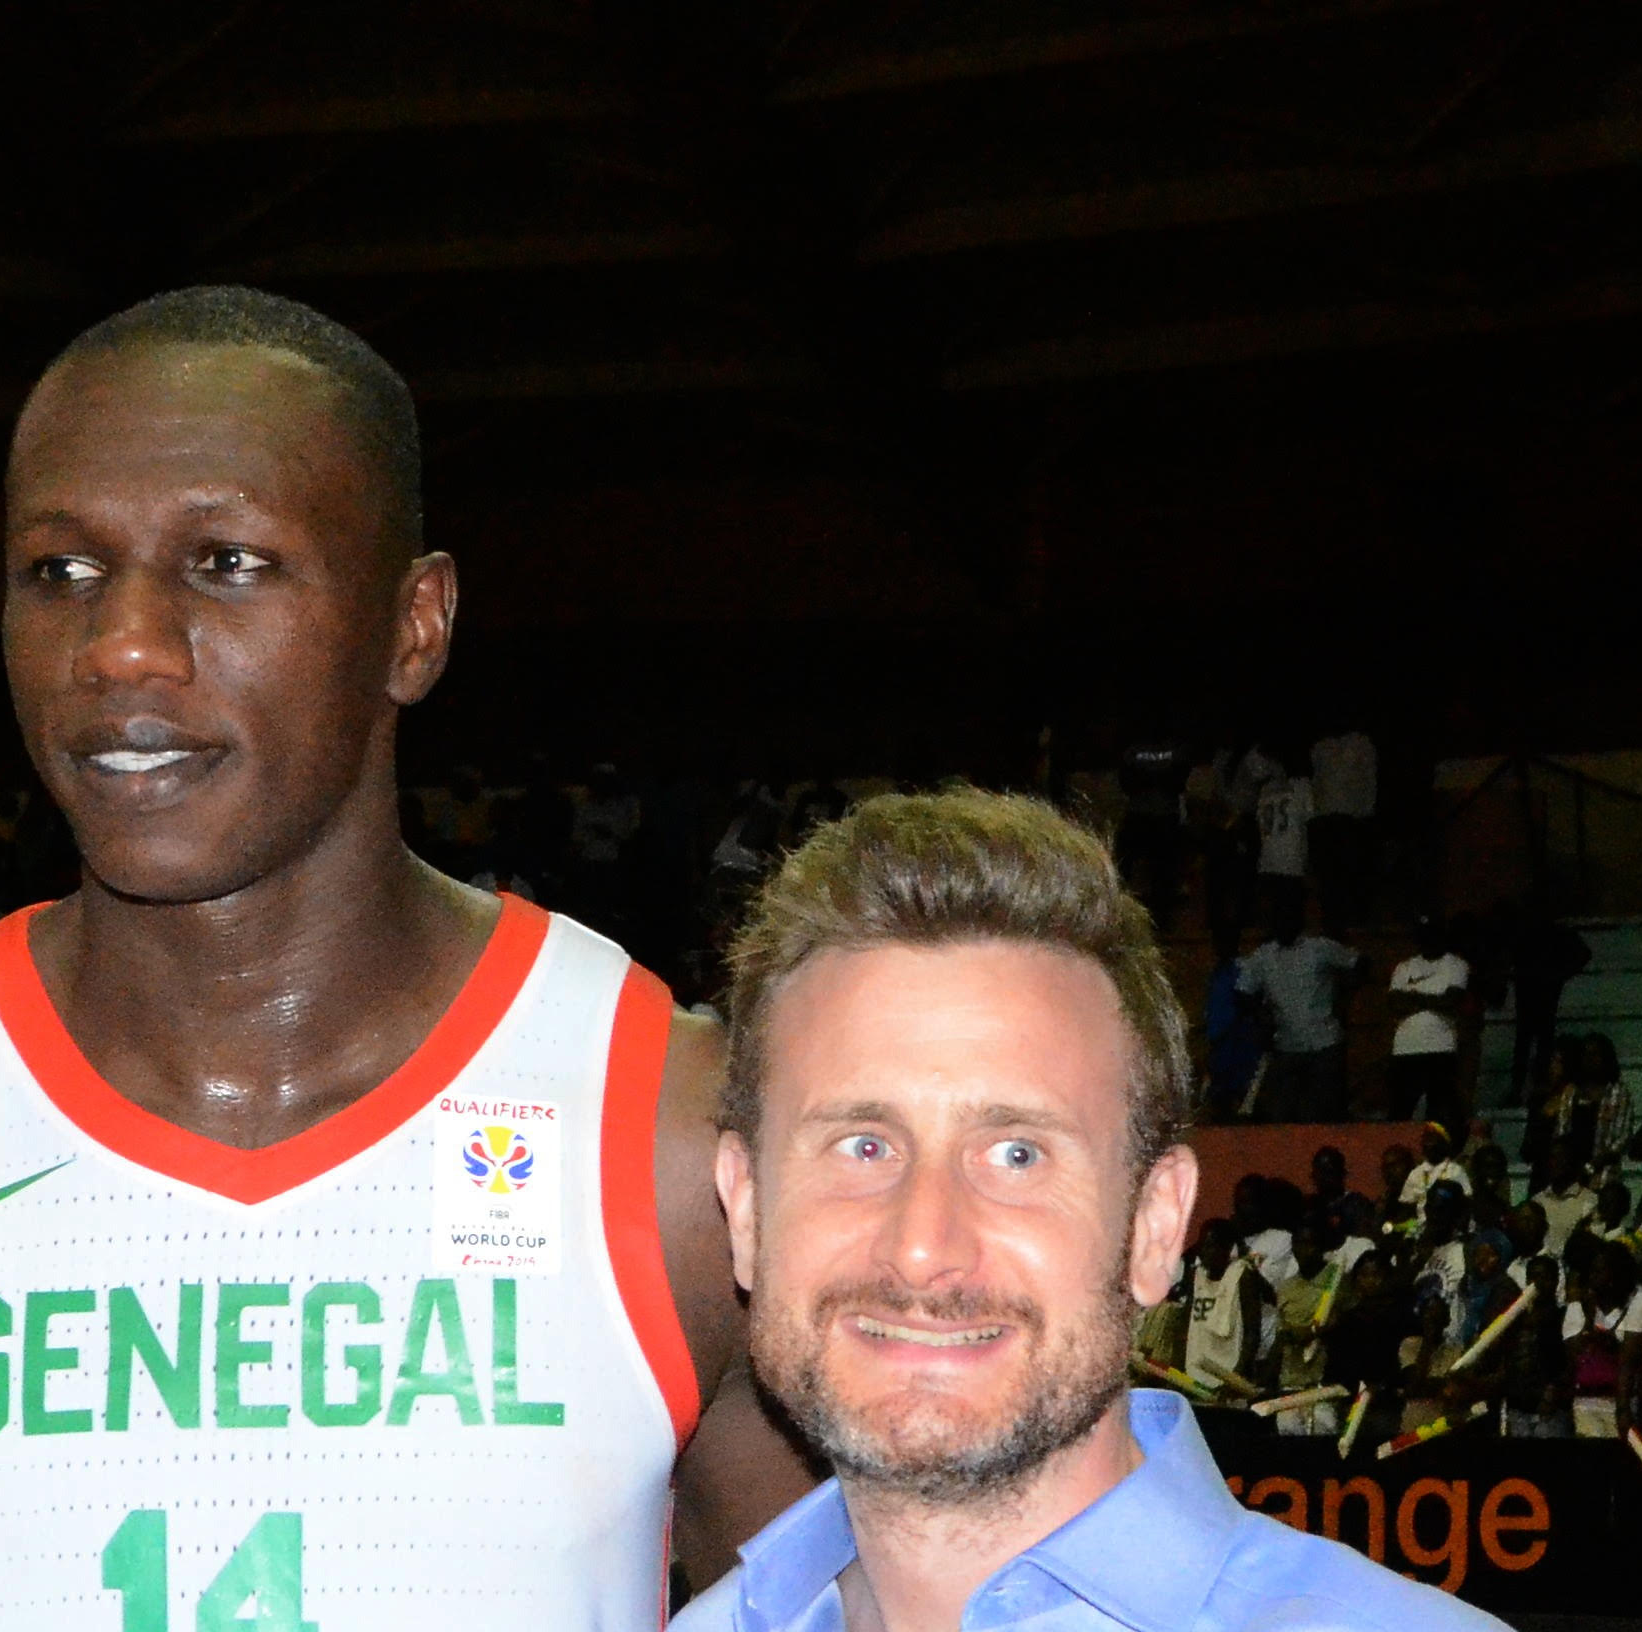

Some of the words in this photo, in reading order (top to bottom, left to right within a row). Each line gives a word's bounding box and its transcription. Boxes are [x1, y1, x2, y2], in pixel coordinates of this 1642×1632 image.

[440, 1097, 556, 1121] QUALIFIERS
[451, 1233, 511, 1247] WORLD
[515, 1235, 546, 1249] CUP
